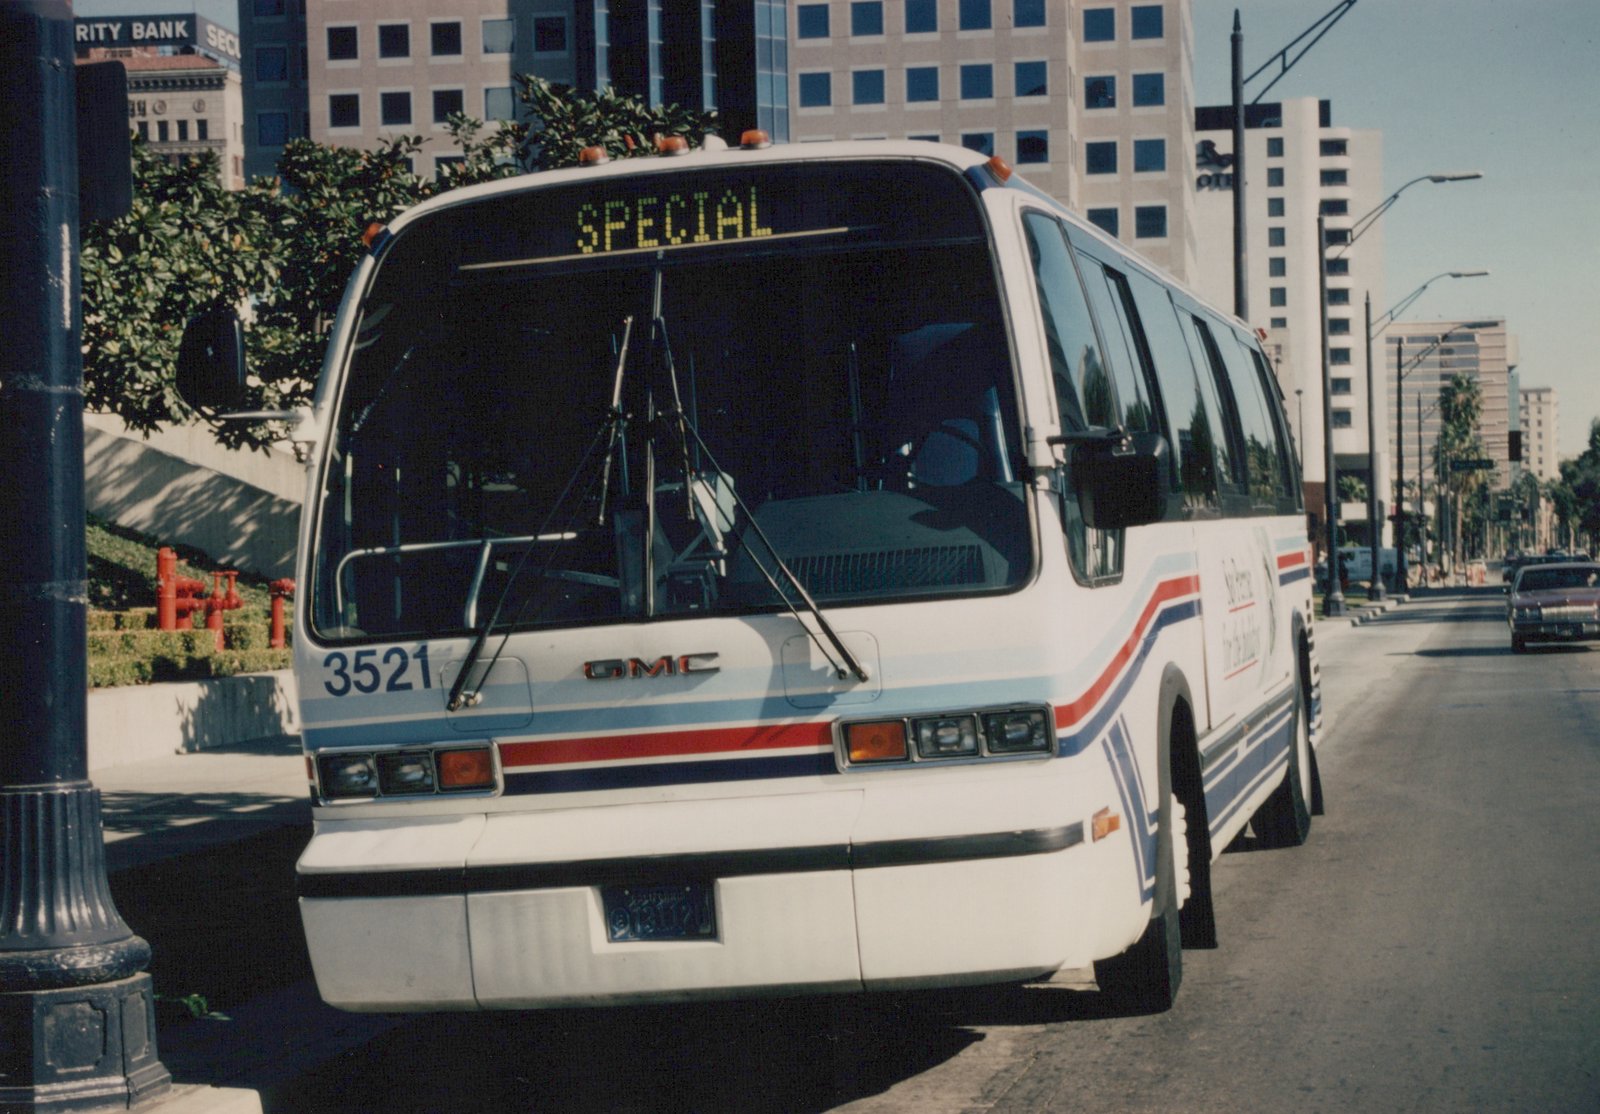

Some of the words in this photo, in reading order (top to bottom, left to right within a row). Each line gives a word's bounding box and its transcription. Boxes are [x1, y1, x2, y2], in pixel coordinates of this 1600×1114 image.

[75, 22, 122, 42] RITY
[132, 20, 189, 40] BANK
[576, 185, 773, 254] SPECIAL
[323, 644, 432, 697] 3521
[583, 651, 721, 680] GMC
